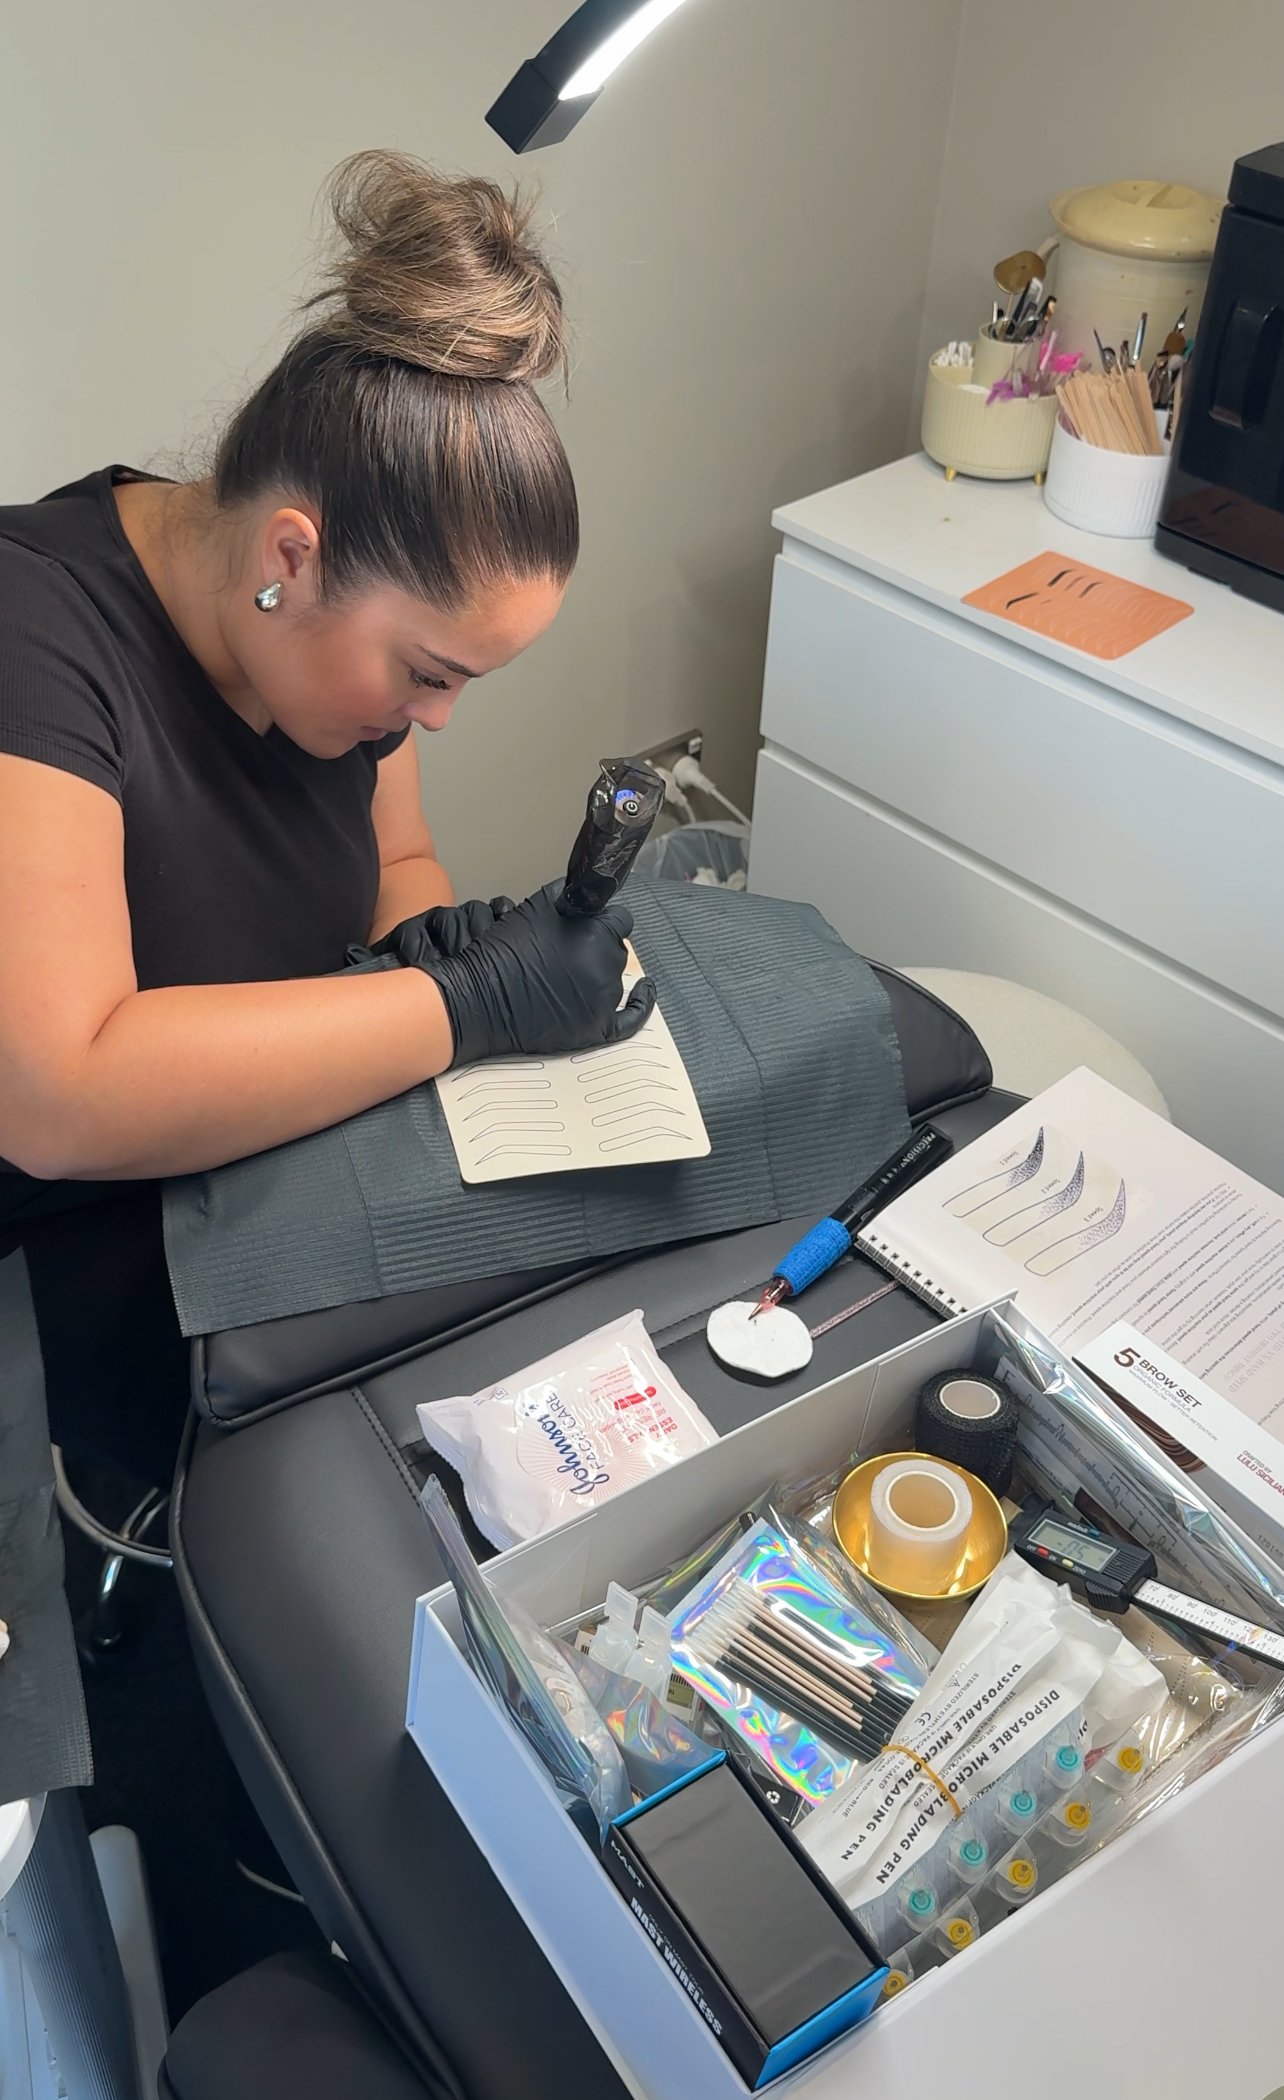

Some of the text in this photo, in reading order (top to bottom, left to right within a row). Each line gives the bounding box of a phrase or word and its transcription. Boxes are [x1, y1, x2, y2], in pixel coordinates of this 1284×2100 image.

[1003, 1151, 1019, 1163] Speed
[1045, 1179, 1061, 1191] Speed
[1088, 1207, 1103, 1219] Speed
[1115, 1346, 1203, 1411] 5 BROW SET
[1132, 1364, 1192, 1413] ORGANIC FORMULA
[545, 1391, 577, 1430] CARE
[1128, 1368, 1154, 1390] MAXIMUM
[1151, 1387, 1168, 1402] FLOW
[1169, 1401, 1190, 1419] BETTER
[1188, 1417, 1219, 1442] RETENTION
[1236, 1453, 1258, 1473] LULU
[1242, 1449, 1272, 1475] CRAFTED BY
[1073, 1565, 1087, 1575] ZERO
[1148, 1582, 1160, 1593] 70
[1167, 1592, 1177, 1601] 80
[1186, 1600, 1197, 1609] 90
[1203, 1607, 1217, 1618] 100
[1223, 1616, 1236, 1627] 110
[1263, 1633, 1277, 1644] 130
[949, 1672, 980, 1705] STERILIZED
[952, 1662, 1022, 1732] DISPOSABLE
[943, 1702, 952, 1712] BY
[984, 1723, 998, 1737] USE
[988, 1689, 1060, 1754] DISPOSABLE
[904, 1734, 931, 1760] PACKAE
[970, 1733, 986, 1750] ONLY
[876, 1763, 901, 1790] SEALED
[938, 1752, 967, 1779] PACKAGE
[865, 1730, 954, 1833] MICROBLADING
[912, 1783, 936, 1808] SEALED
[842, 1799, 858, 1818] BLUE
[899, 1751, 990, 1851] MICROBLADING
[840, 1833, 867, 1862] PEN
[609, 1840, 645, 1887] MAST
[873, 1851, 905, 1885] PEN
[631, 1897, 725, 2036] MAST WIRELESS
